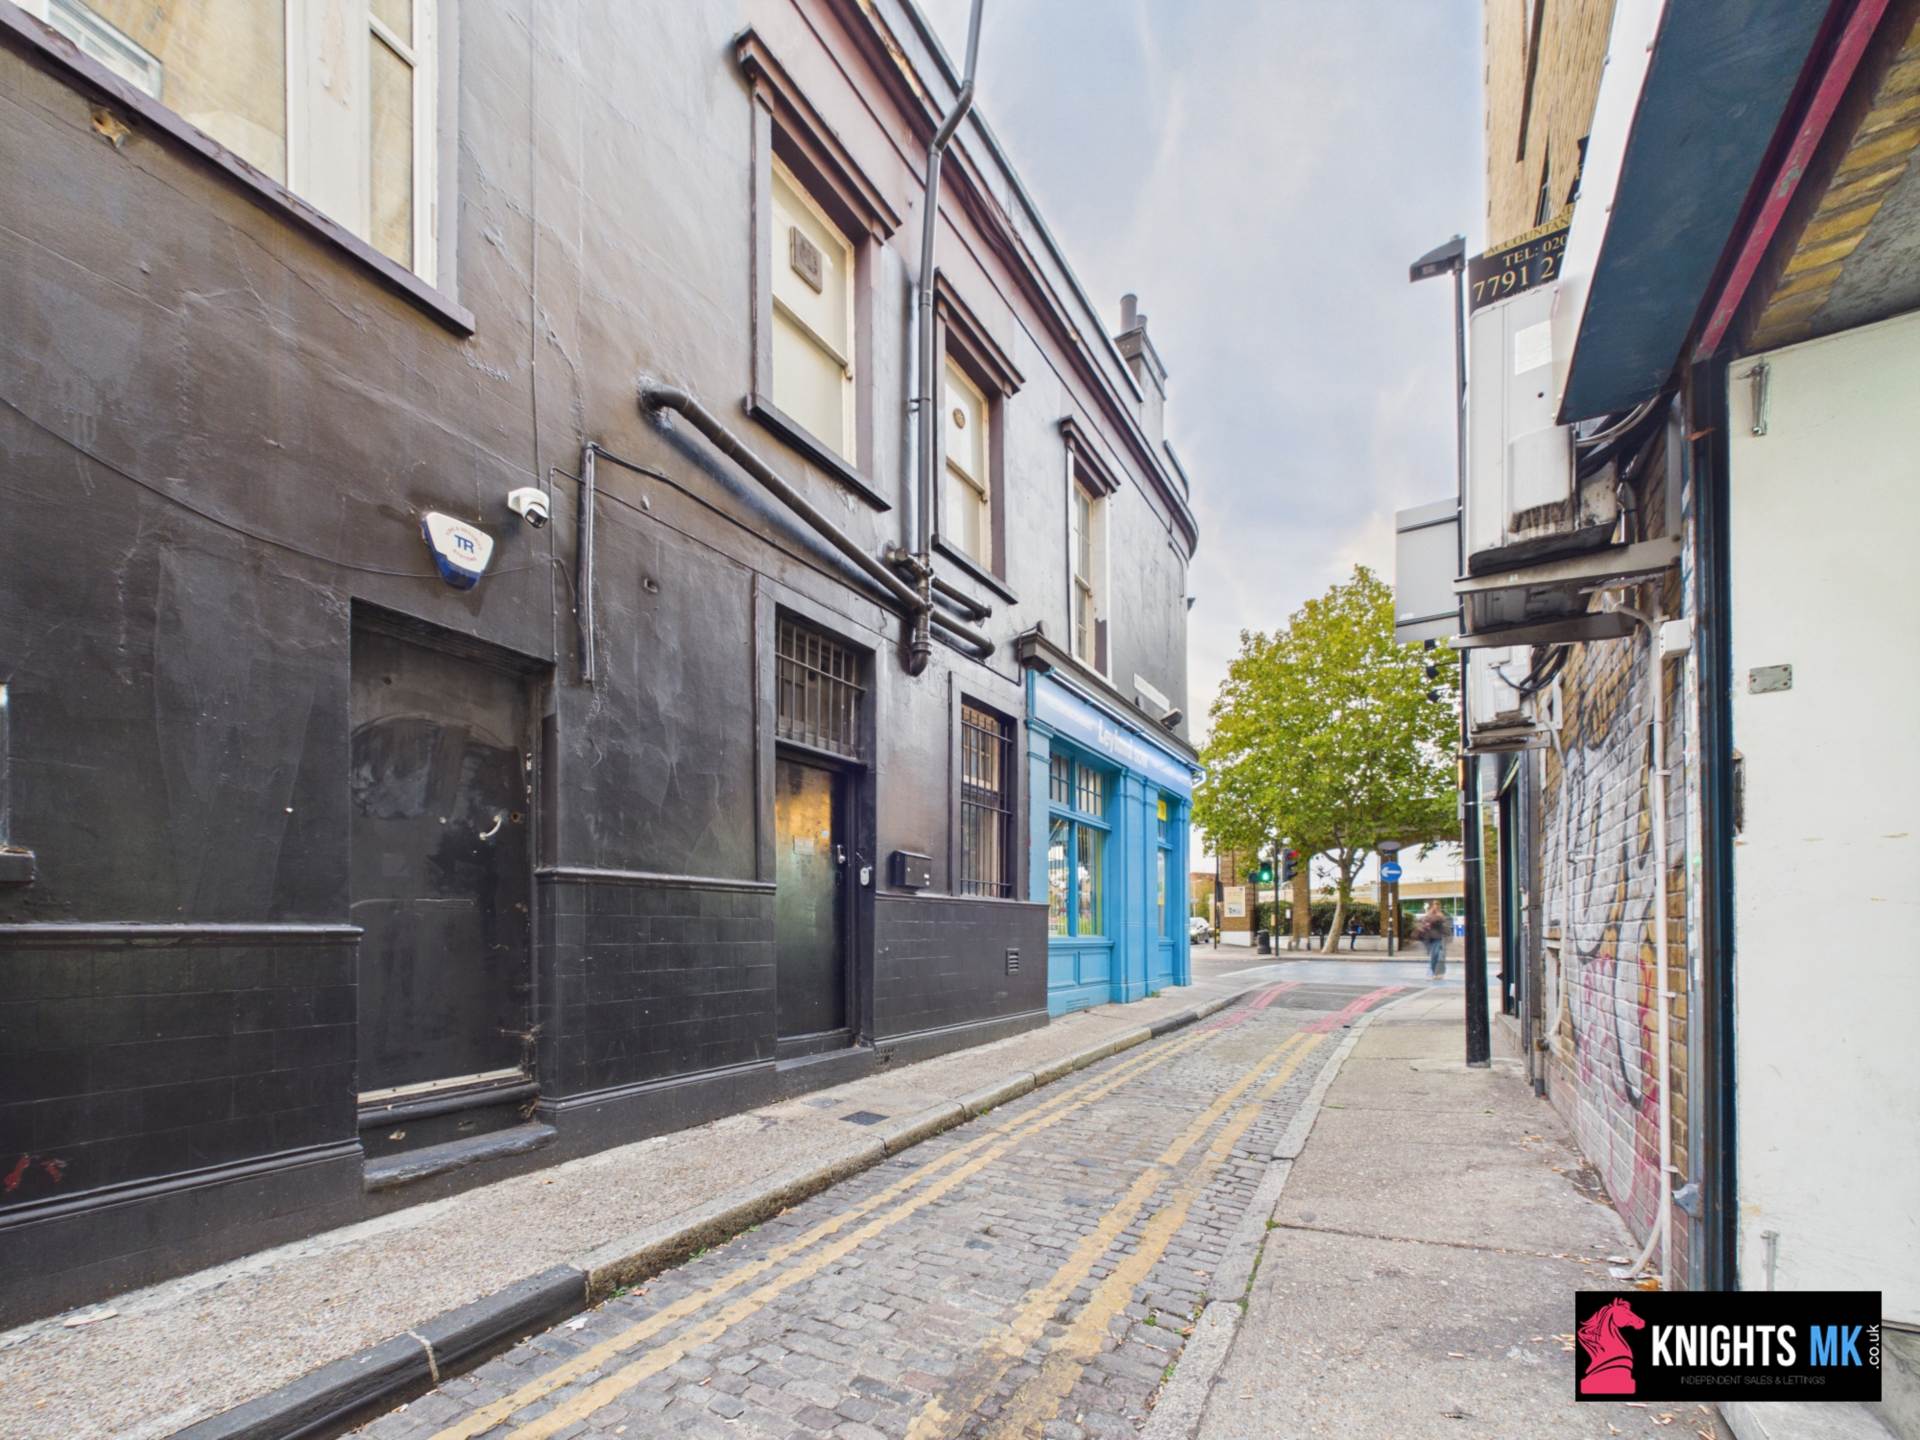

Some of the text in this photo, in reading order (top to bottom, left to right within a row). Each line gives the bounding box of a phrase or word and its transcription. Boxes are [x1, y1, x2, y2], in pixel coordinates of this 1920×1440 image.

[1503, 247, 1539, 267] TEL:
[1473, 265, 1529, 302] 7791
[454, 534, 474, 554] TR
